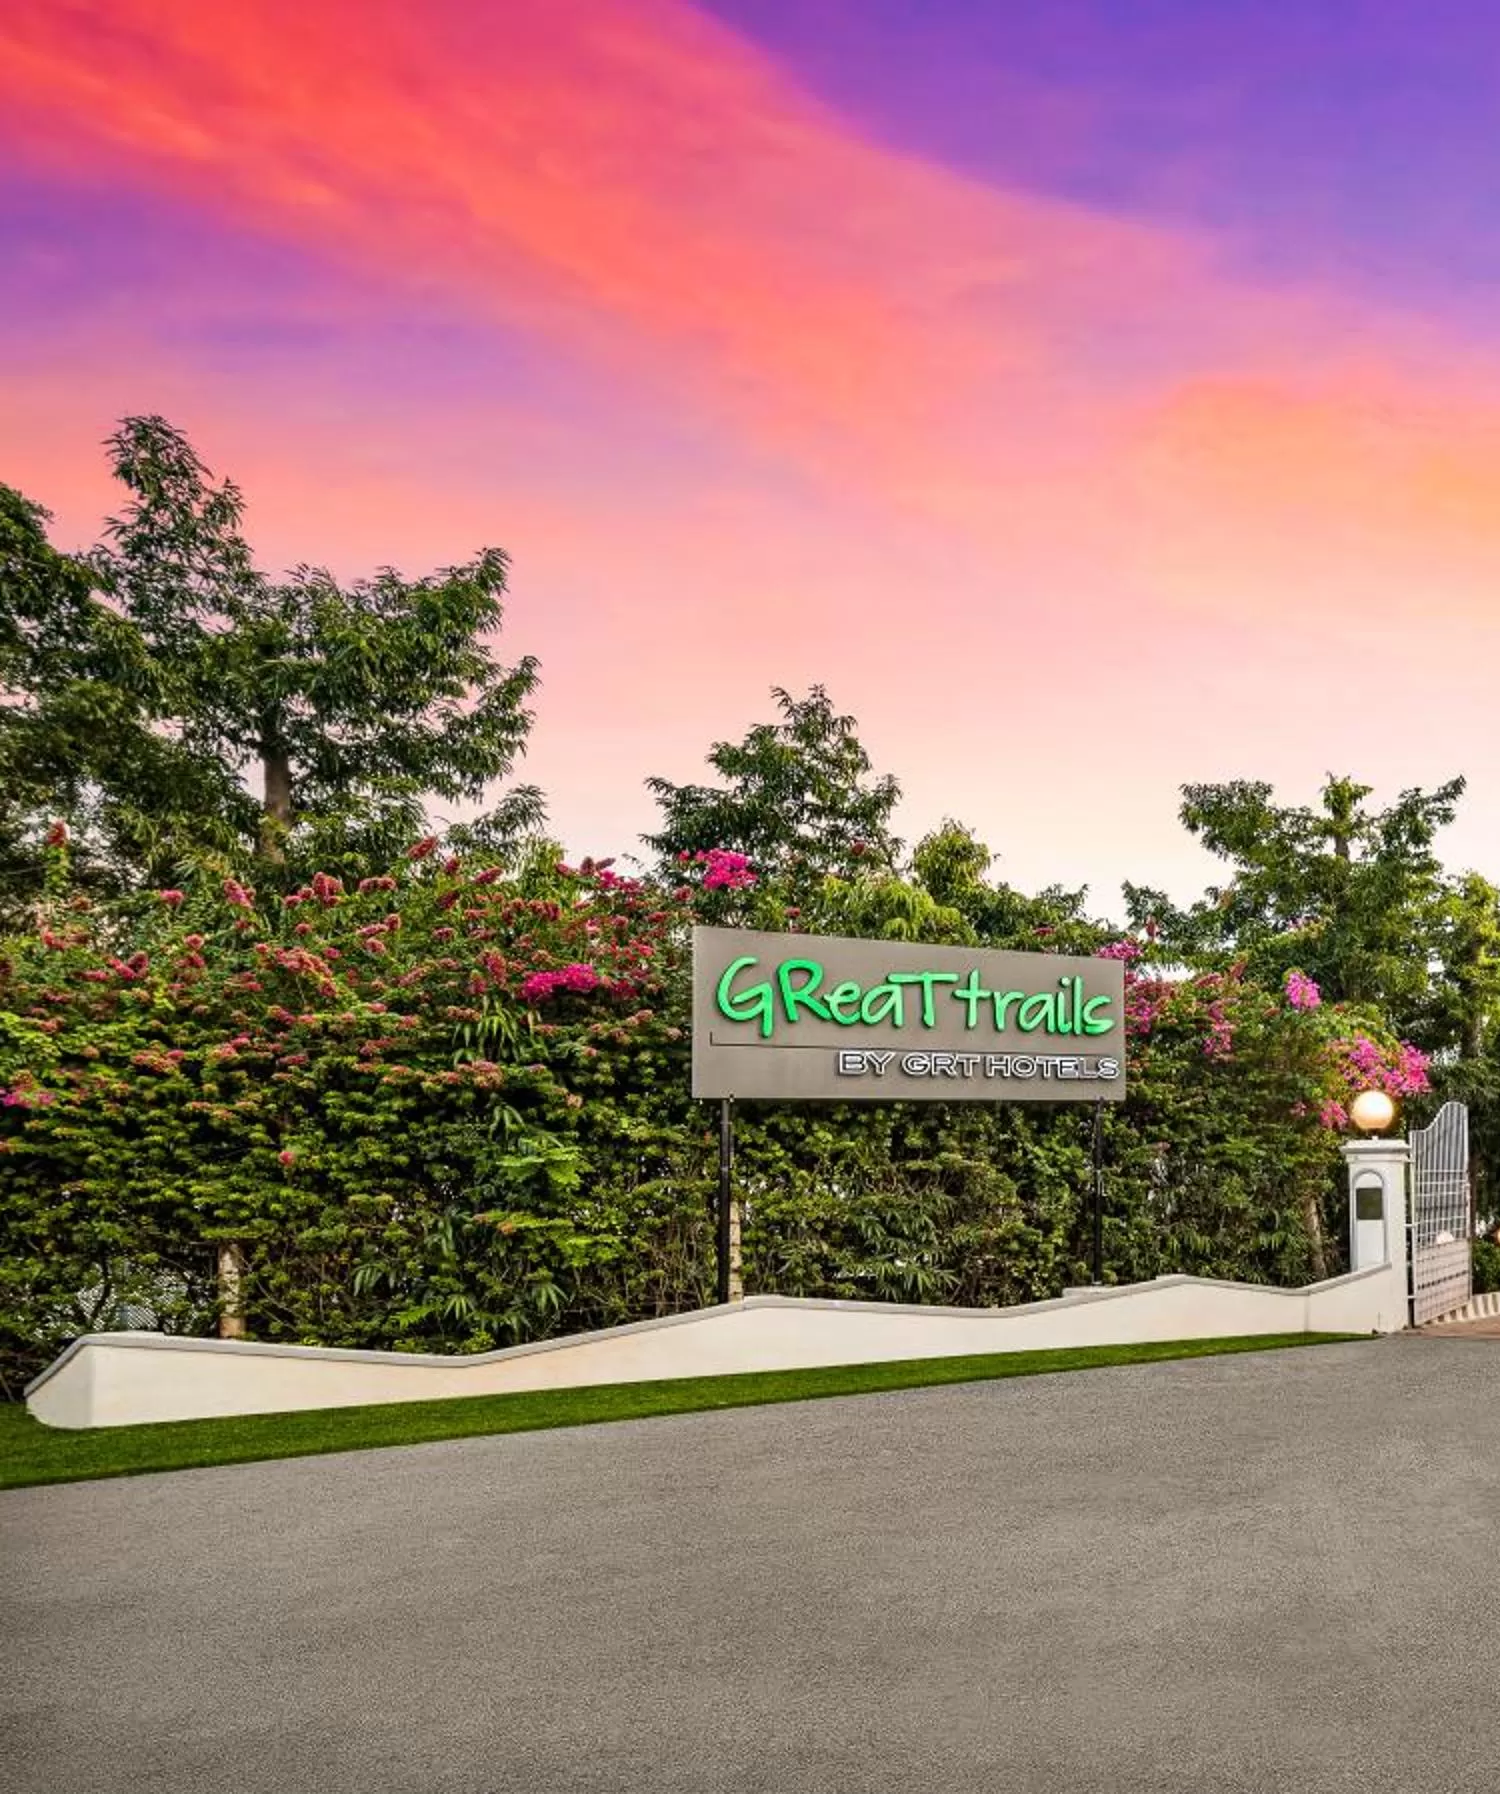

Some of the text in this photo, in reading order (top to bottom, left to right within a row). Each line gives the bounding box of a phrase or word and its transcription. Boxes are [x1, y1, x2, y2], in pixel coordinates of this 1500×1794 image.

[838, 1050, 1120, 1080] BY GRT HOTELS
